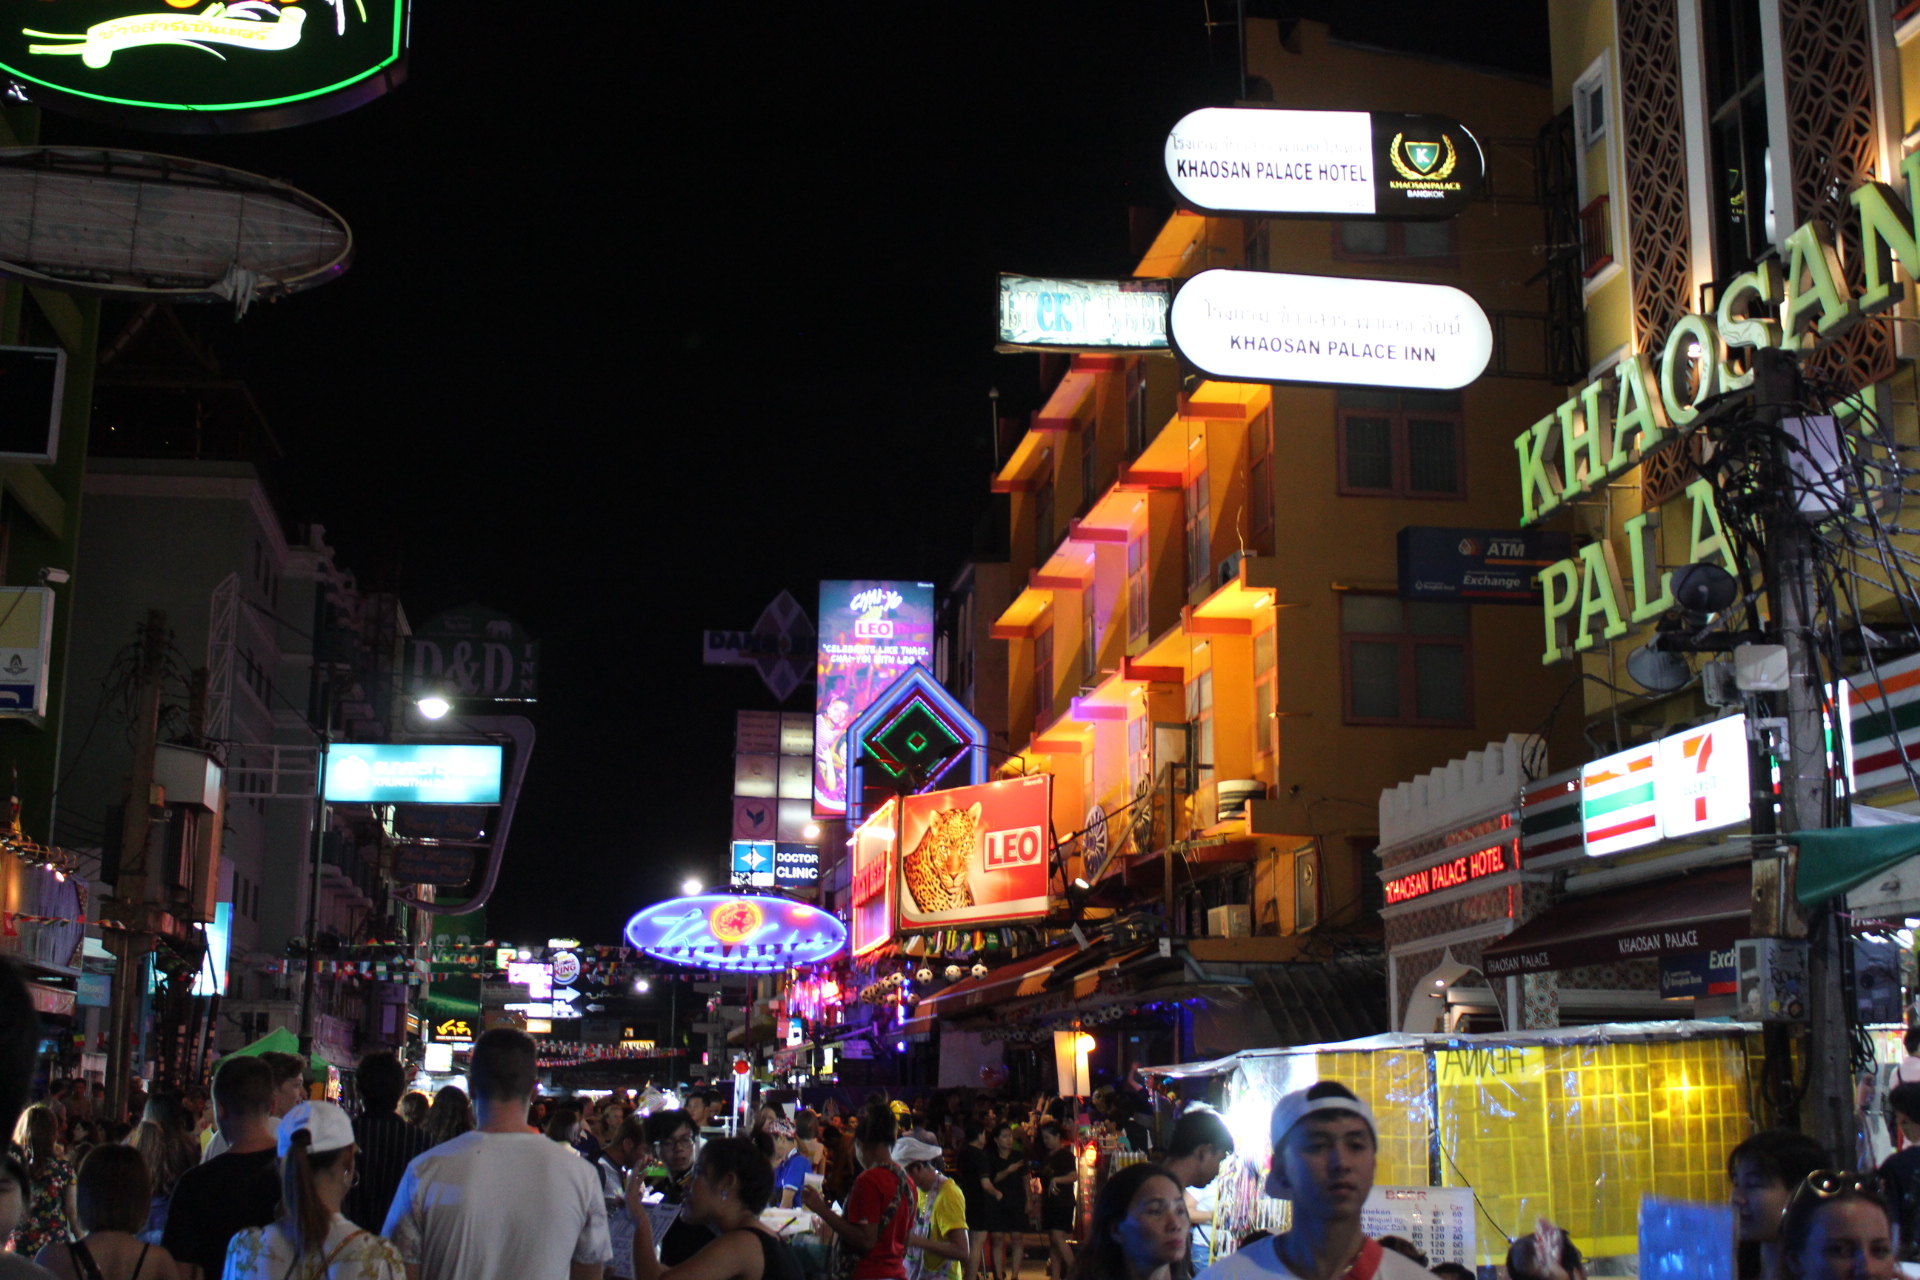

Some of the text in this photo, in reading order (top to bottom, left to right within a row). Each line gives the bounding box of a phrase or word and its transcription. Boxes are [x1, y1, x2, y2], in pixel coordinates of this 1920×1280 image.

[1416, 148, 1430, 163] K
[1176, 159, 1367, 182] KHAOSAN PALACE HOTEL
[1406, 189, 1445, 199] BANGKOK
[1002, 291, 1167, 335] LUCKY BEER
[1514, 148, 1920, 527] KHAOSAN
[1230, 335, 1436, 363] KHAOSAN PALACE INN
[1487, 543, 1525, 557] ATM
[1462, 574, 1521, 589] Exchange
[850, 588, 903, 612] CHAI-YO
[858, 623, 891, 636] LEO
[878, 645, 899, 655] LIKE
[412, 640, 514, 695] D&D
[874, 655, 895, 665] WITH
[1682, 733, 1713, 822] 7
[988, 830, 1039, 866] LEO
[776, 852, 819, 865] DOCTOR
[776, 866, 819, 880] CLINIC
[1387, 845, 1505, 904] KHAOSAN PALACE HOTEL
[1619, 930, 1699, 954] KHAOSAN PALACE
[1521, 951, 1550, 968] PALACE
[1385, 1189, 1427, 1201] BEER
[1431, 1248, 1445, 1256] 120
